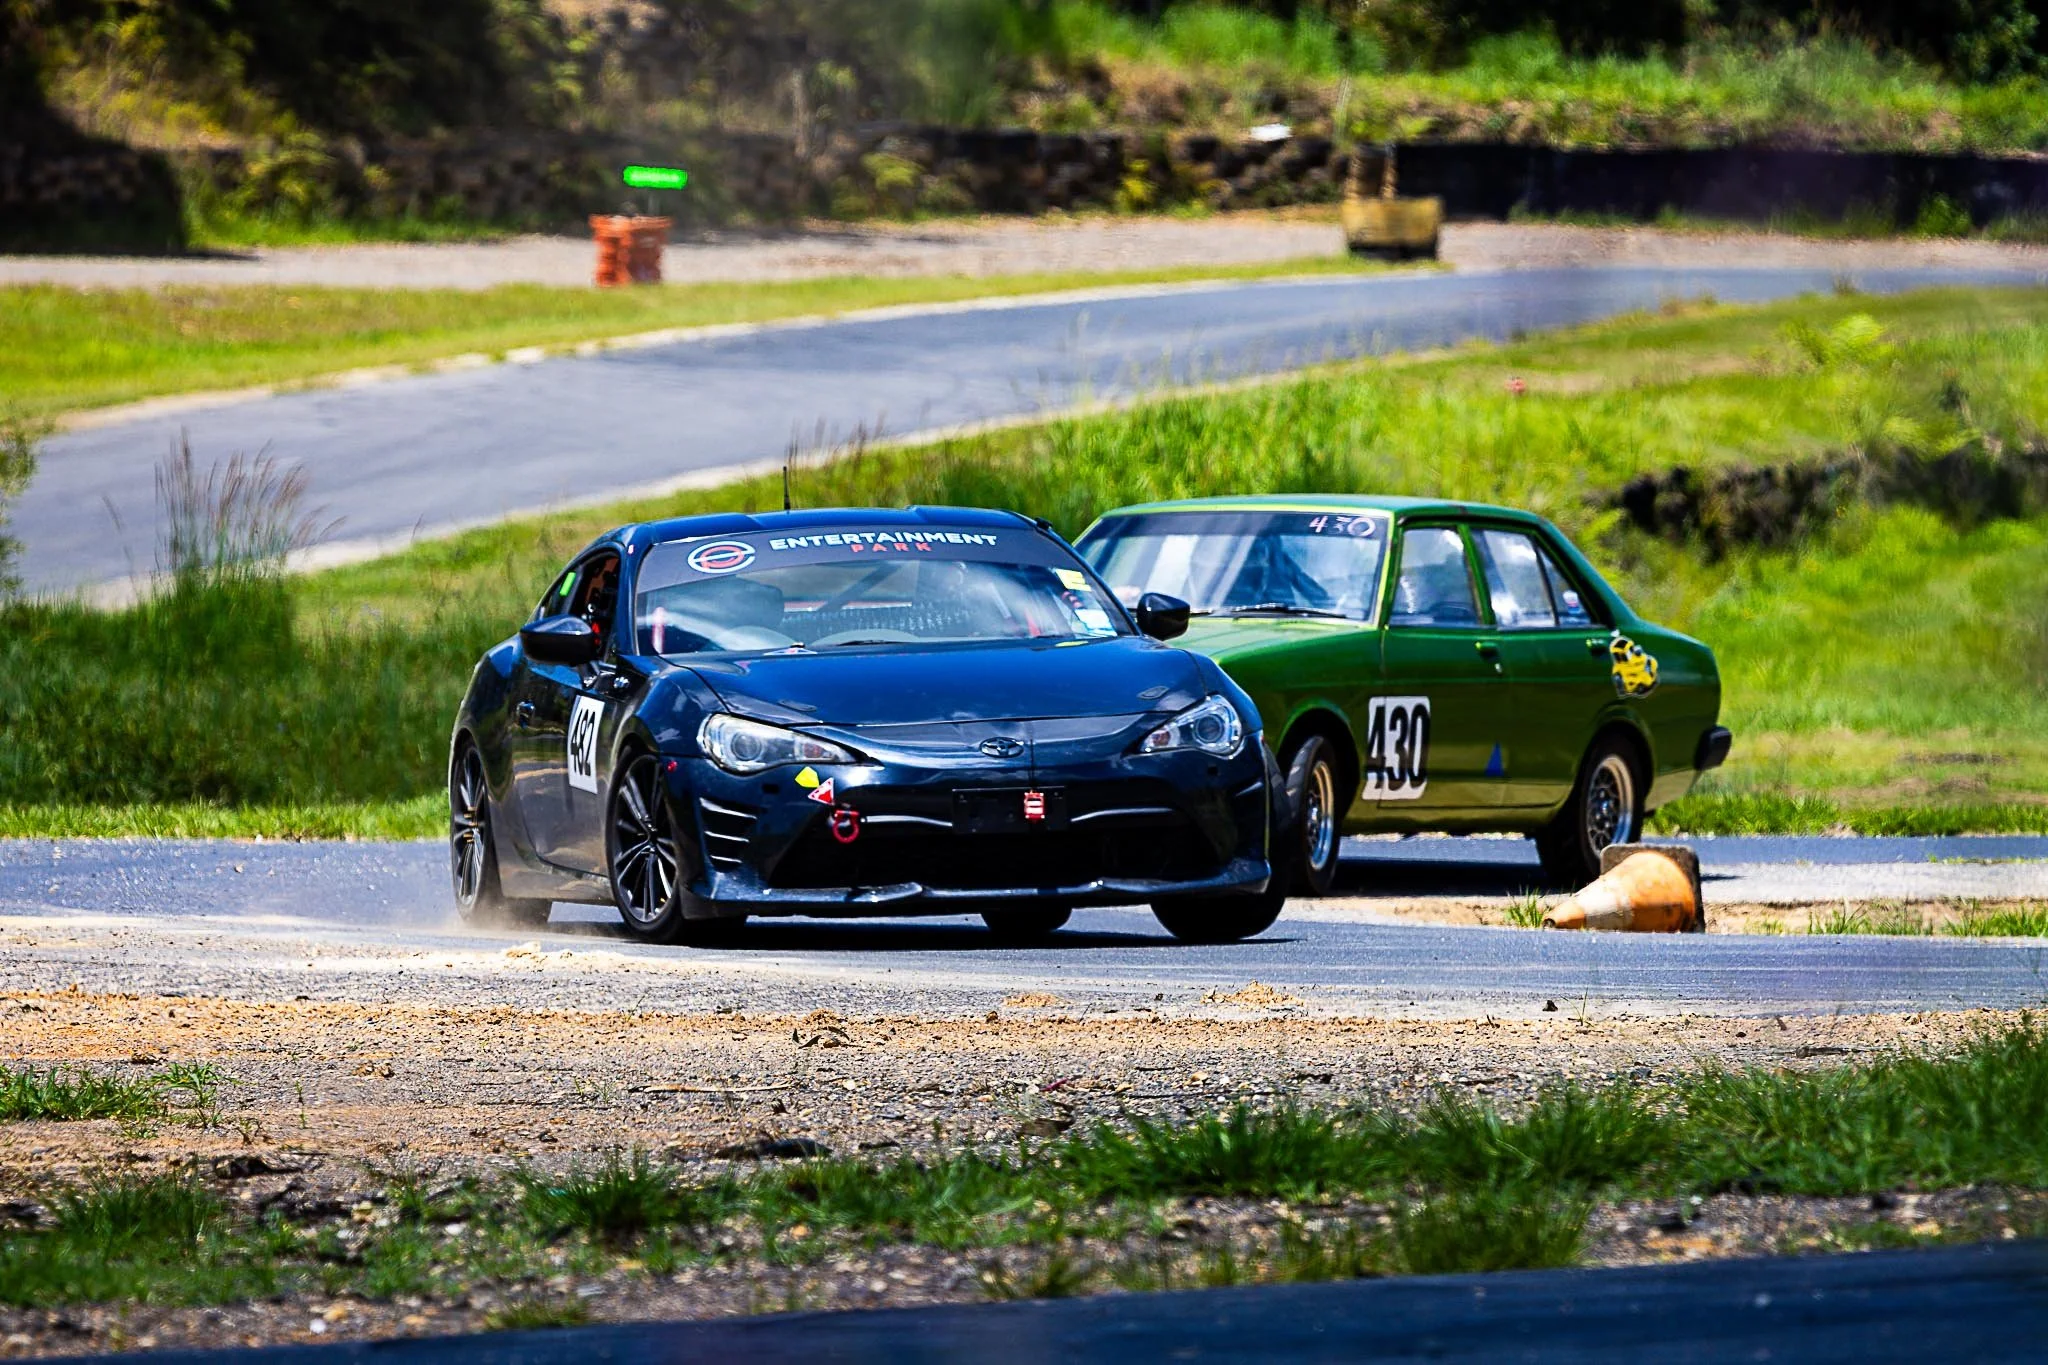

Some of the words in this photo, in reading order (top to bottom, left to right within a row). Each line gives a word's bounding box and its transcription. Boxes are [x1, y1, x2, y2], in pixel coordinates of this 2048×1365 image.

[769, 532, 997, 551] ENTERTAINMENT
[851, 543, 932, 553] PARK
[570, 709, 596, 777] 482
[1365, 703, 1431, 791] 430
